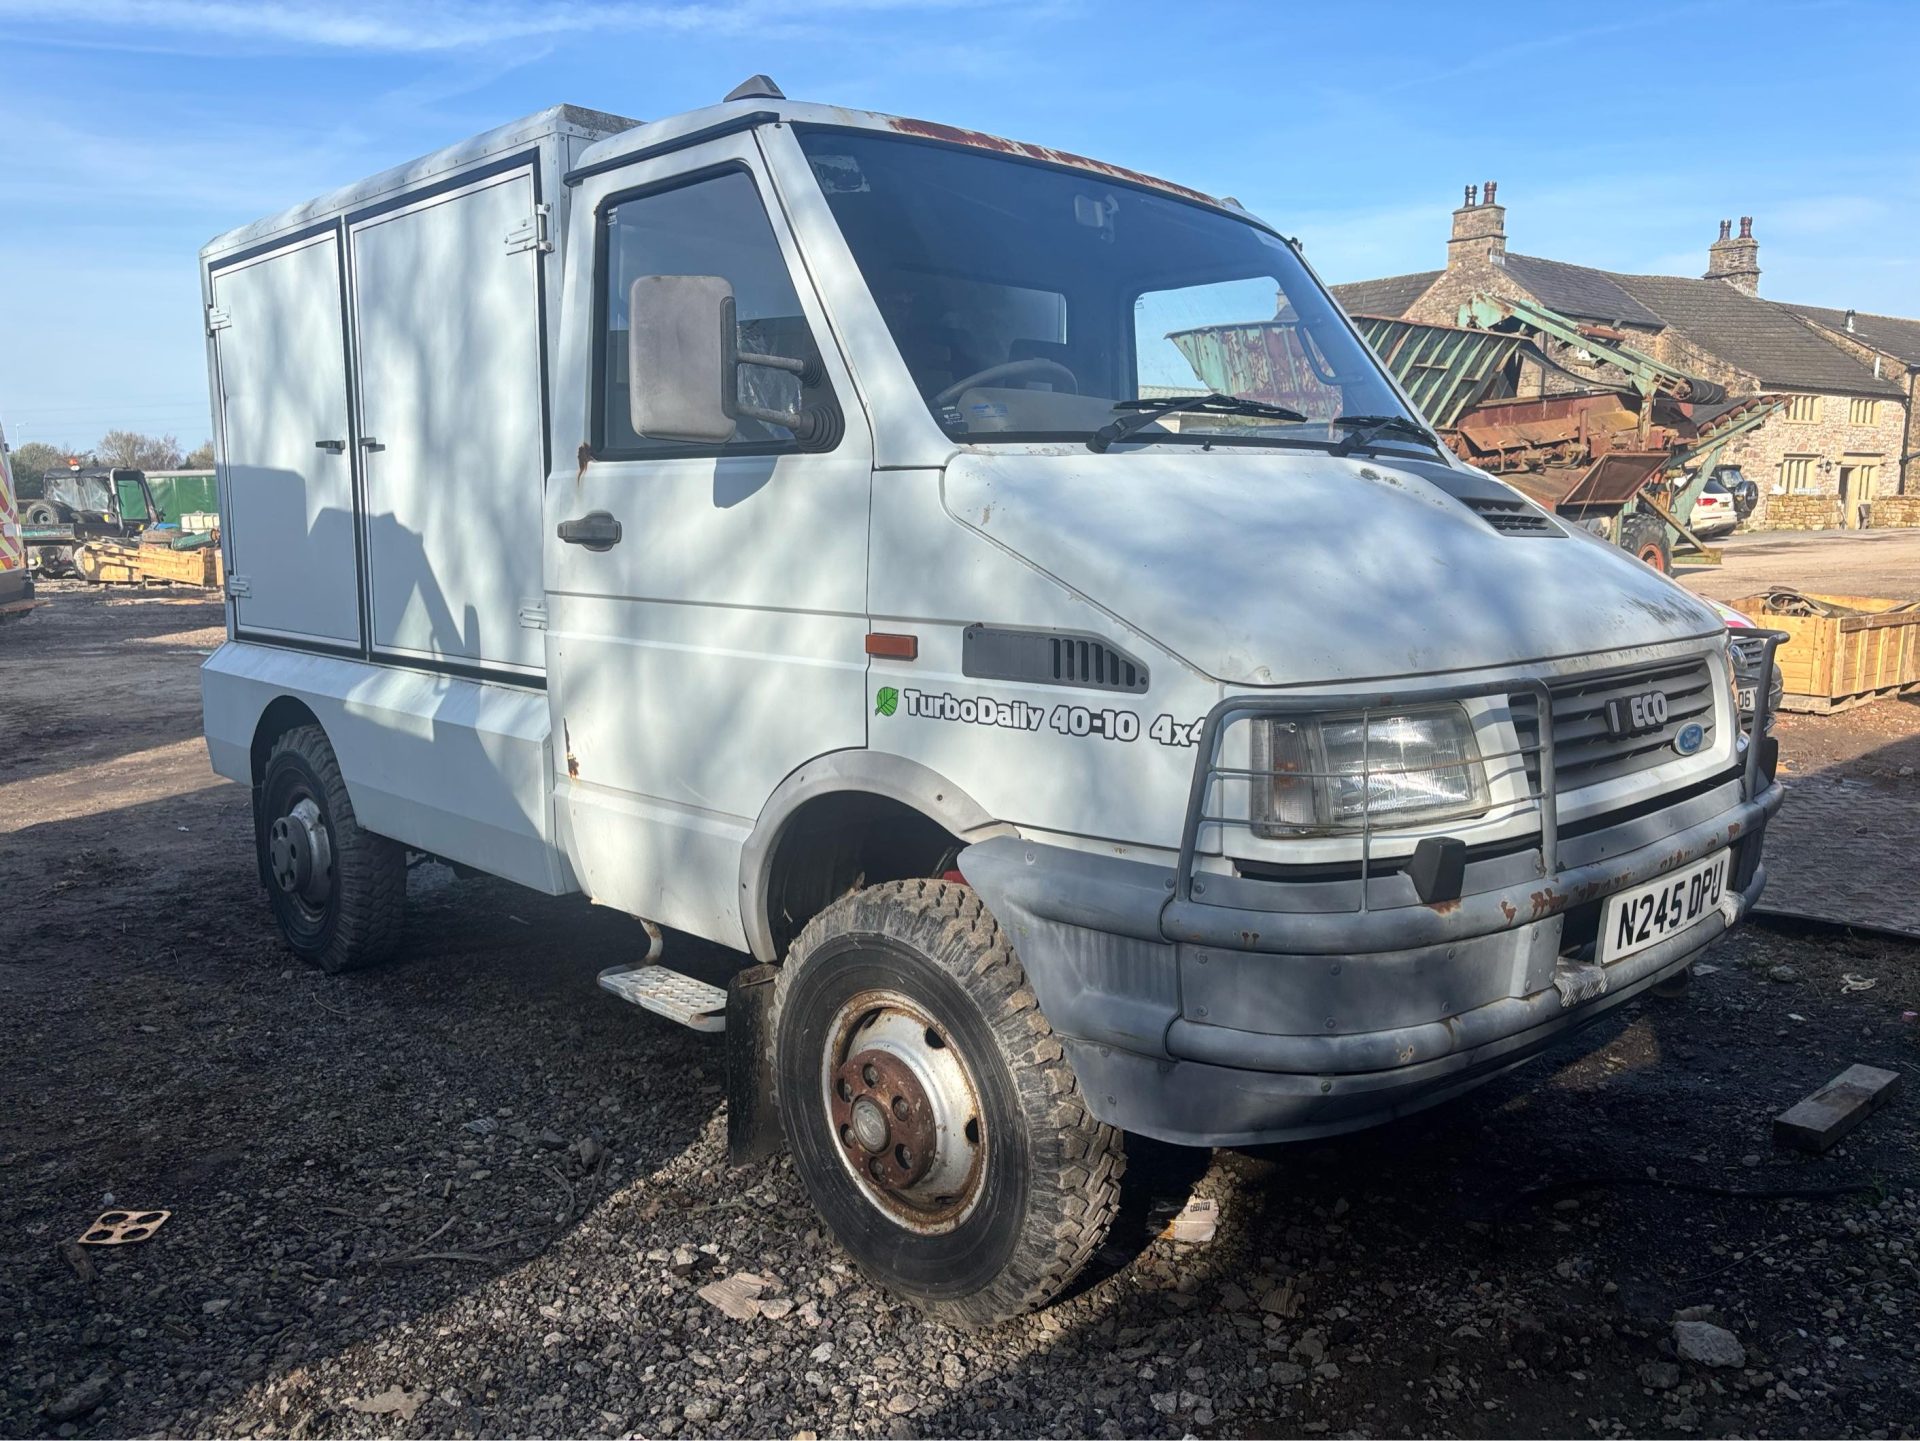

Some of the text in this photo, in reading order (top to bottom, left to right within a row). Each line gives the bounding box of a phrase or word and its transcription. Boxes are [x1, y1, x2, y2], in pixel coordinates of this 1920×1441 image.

[904, 688, 1045, 731] TurboDaily
[1050, 704, 1140, 742] 40-10
[1617, 861, 1724, 950] N245 DPU
